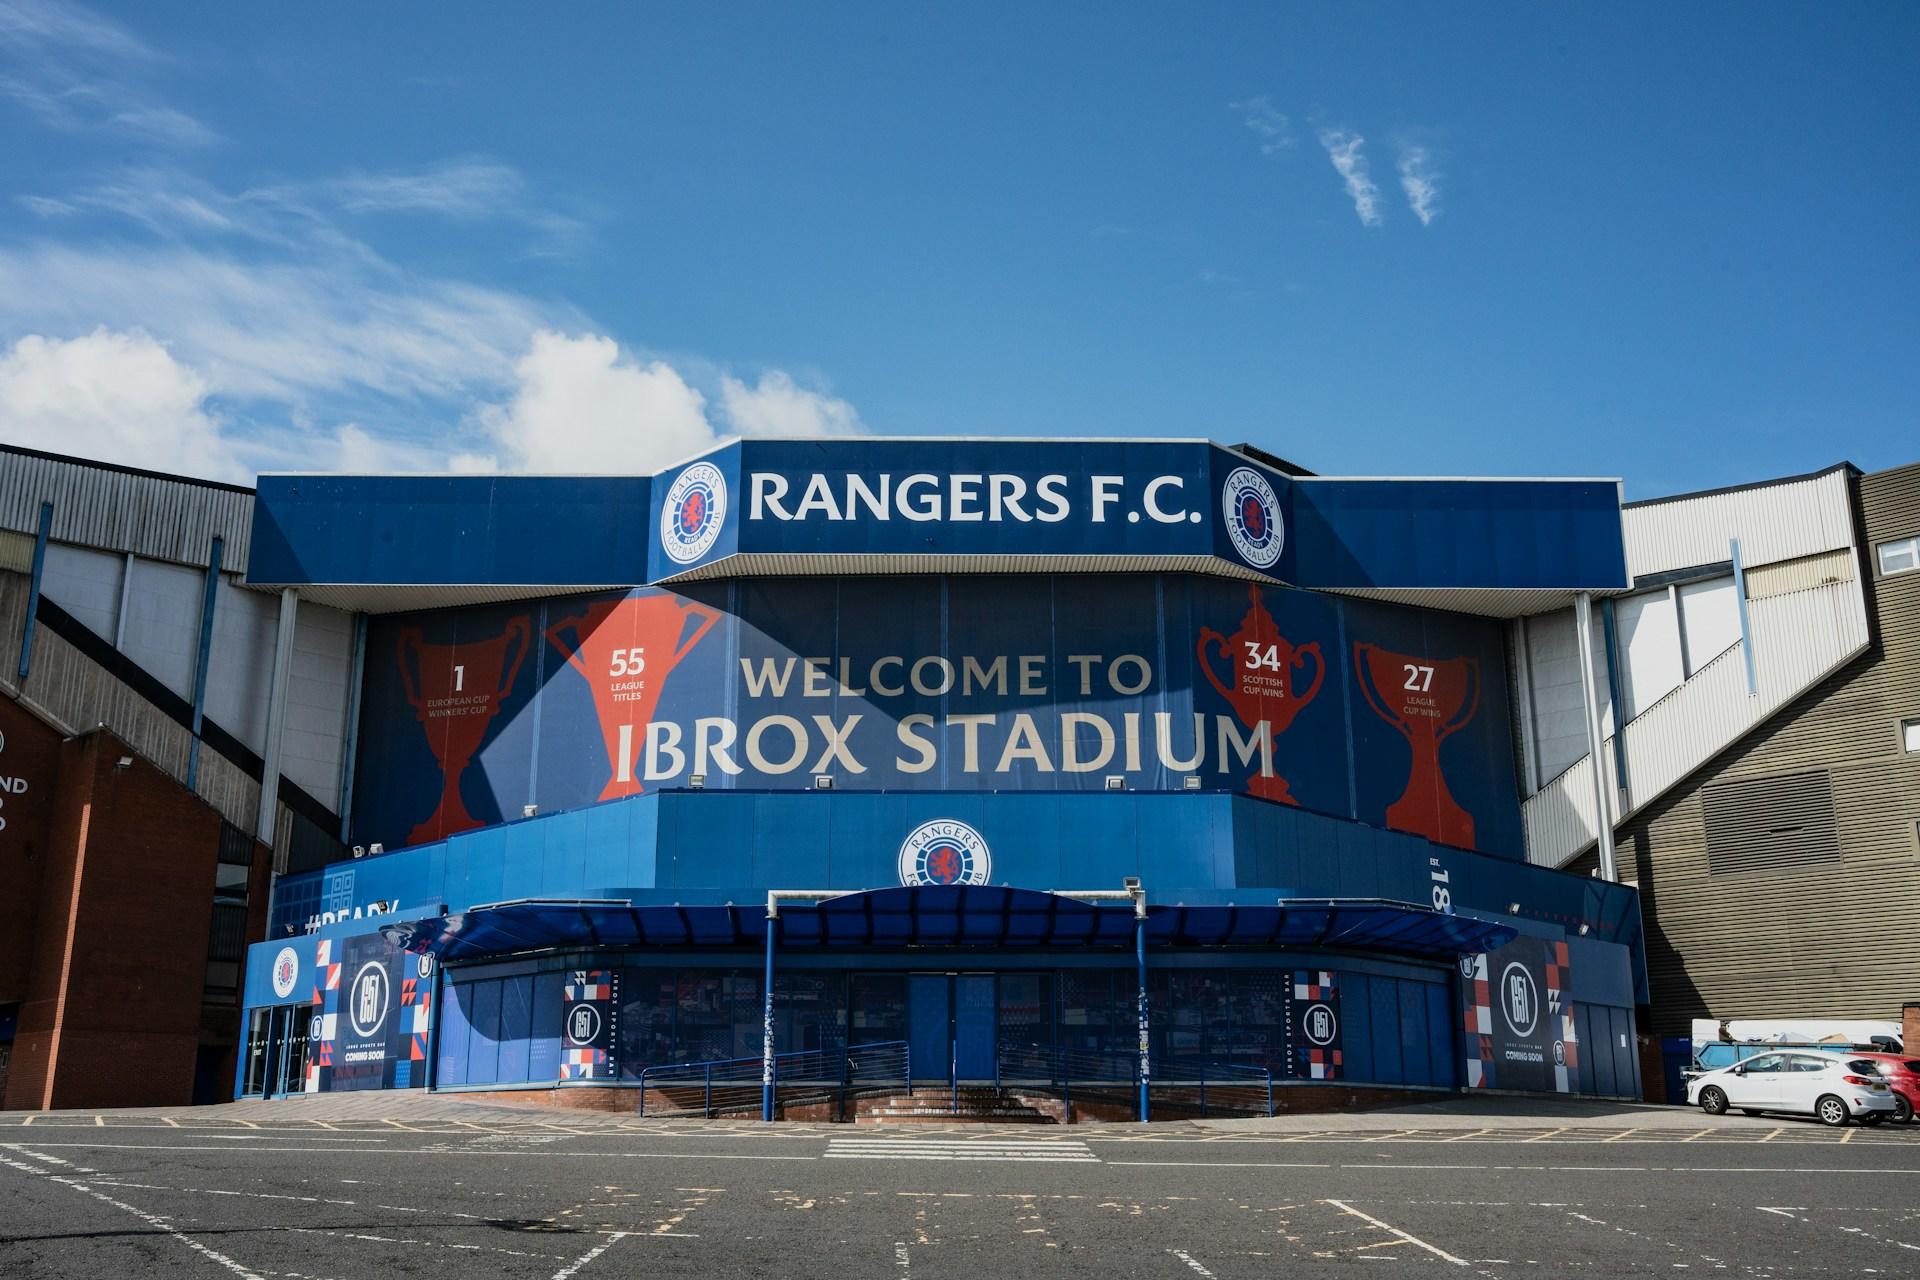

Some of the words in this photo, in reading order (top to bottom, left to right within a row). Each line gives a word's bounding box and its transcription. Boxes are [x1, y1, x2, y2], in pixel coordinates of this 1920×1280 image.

[671, 469, 719, 503] RANGERS
[749, 473, 1070, 522] RANGERS
[1091, 475, 1202, 523] F.C.
[1230, 473, 1275, 509] RANGERS
[1229, 518, 1267, 560] FOOTBALL
[1266, 534, 1280, 558] CLUB
[609, 647, 646, 677] 55
[1244, 641, 1281, 672] 34
[454, 665, 465, 691] 1
[611, 681, 645, 691] LEAGUE
[740, 655, 1047, 698] WELCOME
[1068, 654, 1151, 695] TO
[1242, 675, 1283, 688] SCOTTISH
[1403, 664, 1434, 692] 27
[427, 697, 471, 707] EUROPEAN
[472, 695, 490, 705] CUP
[613, 692, 642, 702] TITLES
[1243, 686, 1260, 695] CUP
[1261, 687, 1284, 698] WINS
[1407, 696, 1436, 707] LEAGUE
[470, 705, 487, 715] CUP
[1403, 706, 1419, 716] CUP
[1420, 708, 1441, 718] WINS
[616, 714, 868, 782] IBROX
[896, 712, 1274, 778] STADIUM
[911, 825, 979, 850] RANGERS
[360, 974, 379, 1023] G51
[1510, 975, 1529, 1023] G51
[575, 1011, 590, 1037] G51
[1314, 1011, 1329, 1038] G51
[345, 1051, 368, 1062] COMING
[368, 1050, 385, 1060] SOON
[1506, 1050, 1527, 1061] COMING
[1528, 1052, 1543, 1063] SOON
